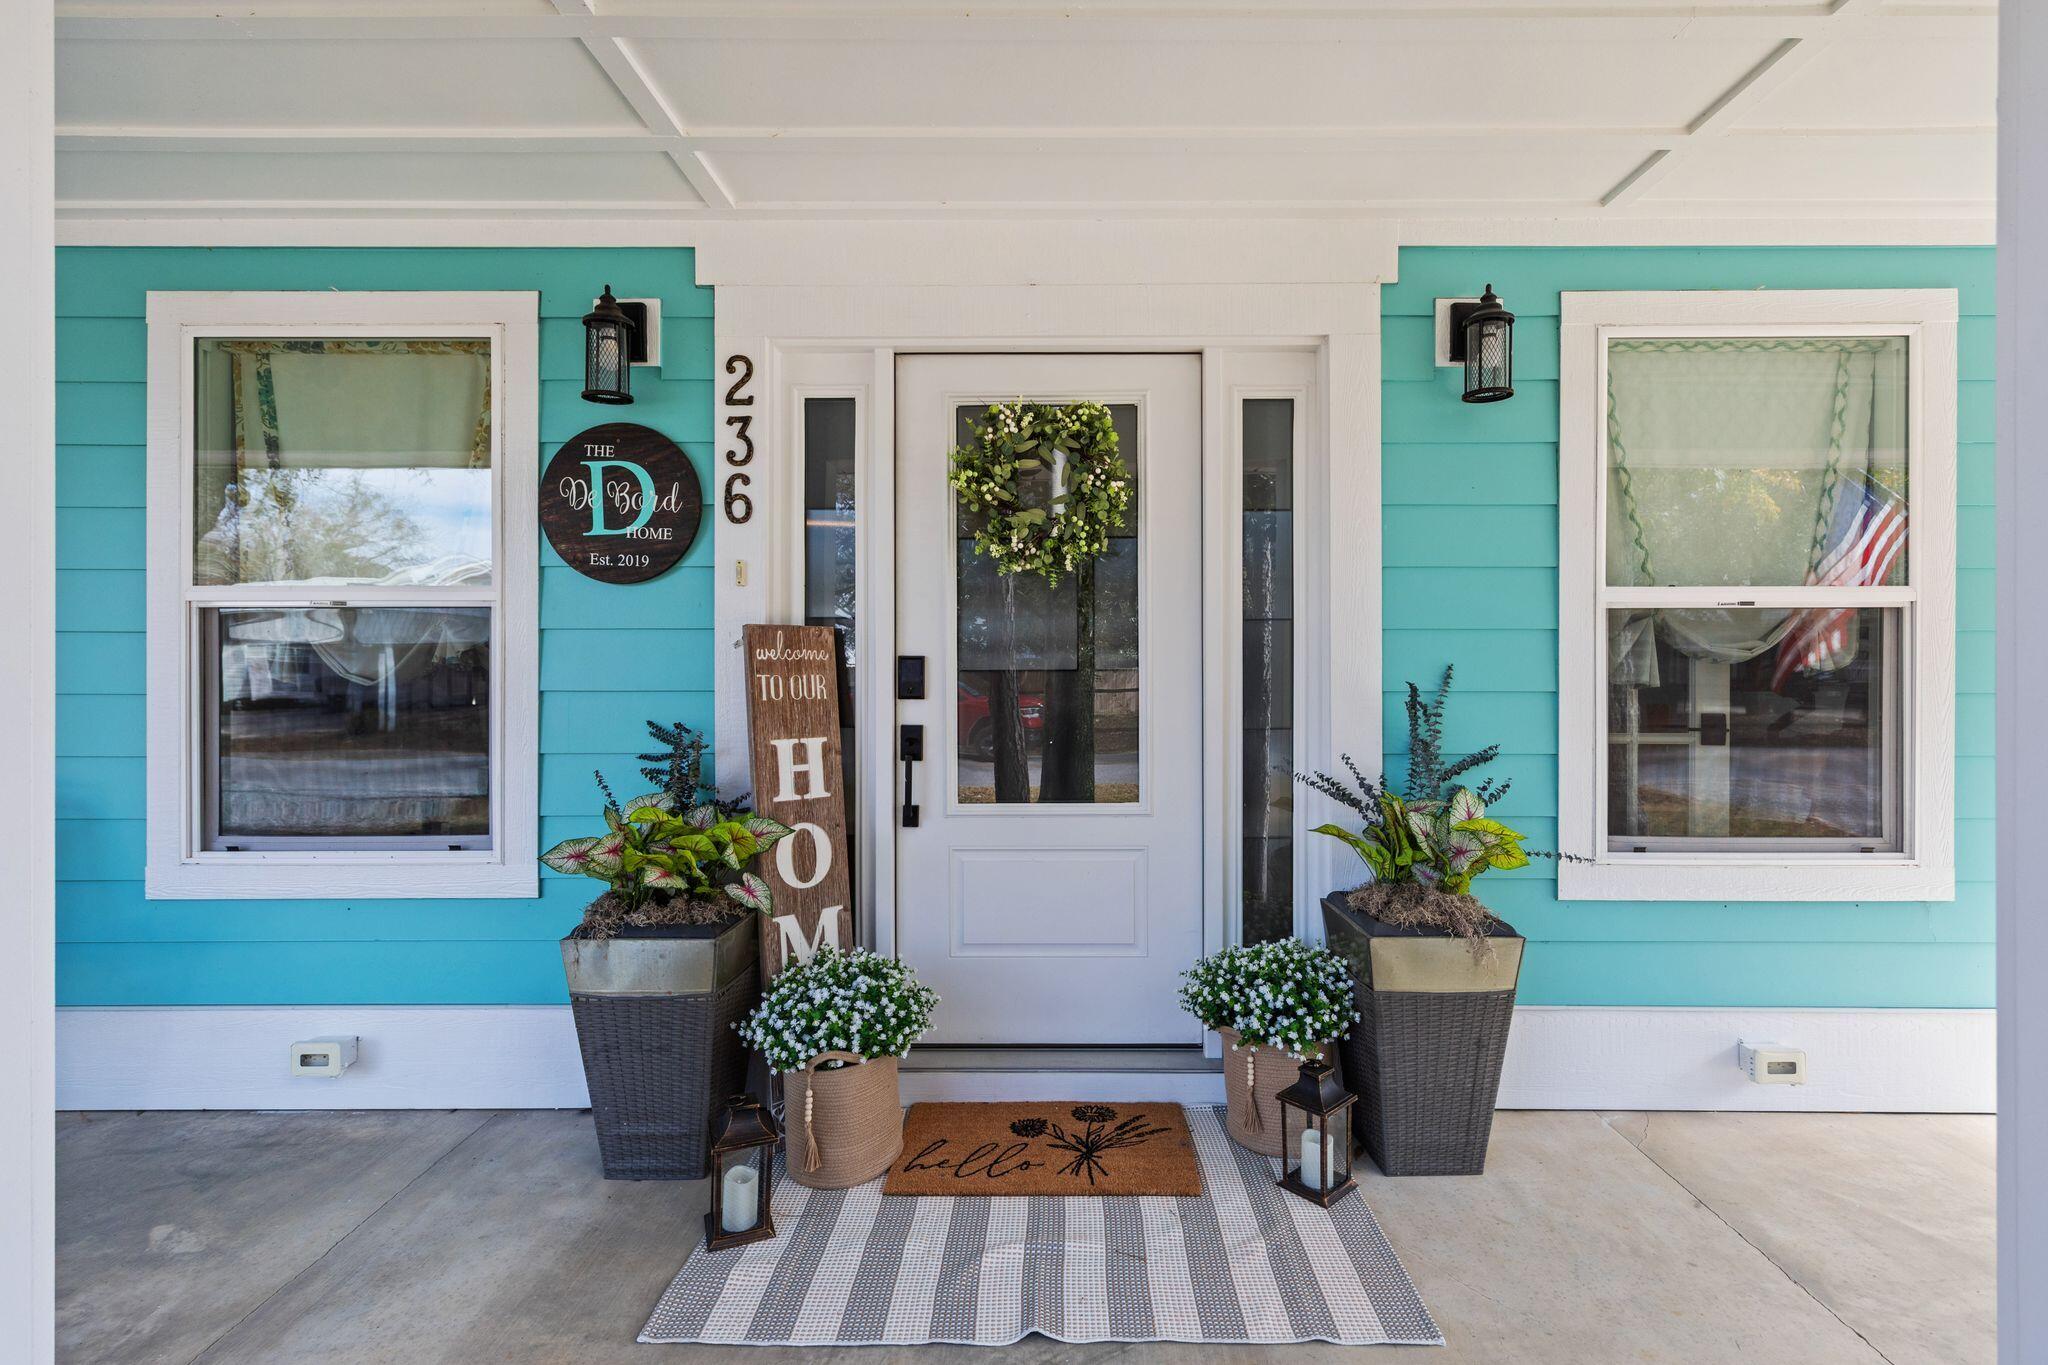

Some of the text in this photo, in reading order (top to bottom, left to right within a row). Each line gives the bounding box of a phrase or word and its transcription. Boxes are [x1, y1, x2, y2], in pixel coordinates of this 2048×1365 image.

[584, 444, 615, 458] THE
[724, 354, 755, 524] 236
[580, 460, 656, 536] D
[626, 526, 673, 540] HOME
[590, 553, 650, 567] Est. 2019
[756, 630, 829, 661] welcome
[756, 674, 828, 701] TO OUR
[770, 736, 844, 969] HOM
[903, 1138, 1045, 1179] hello
